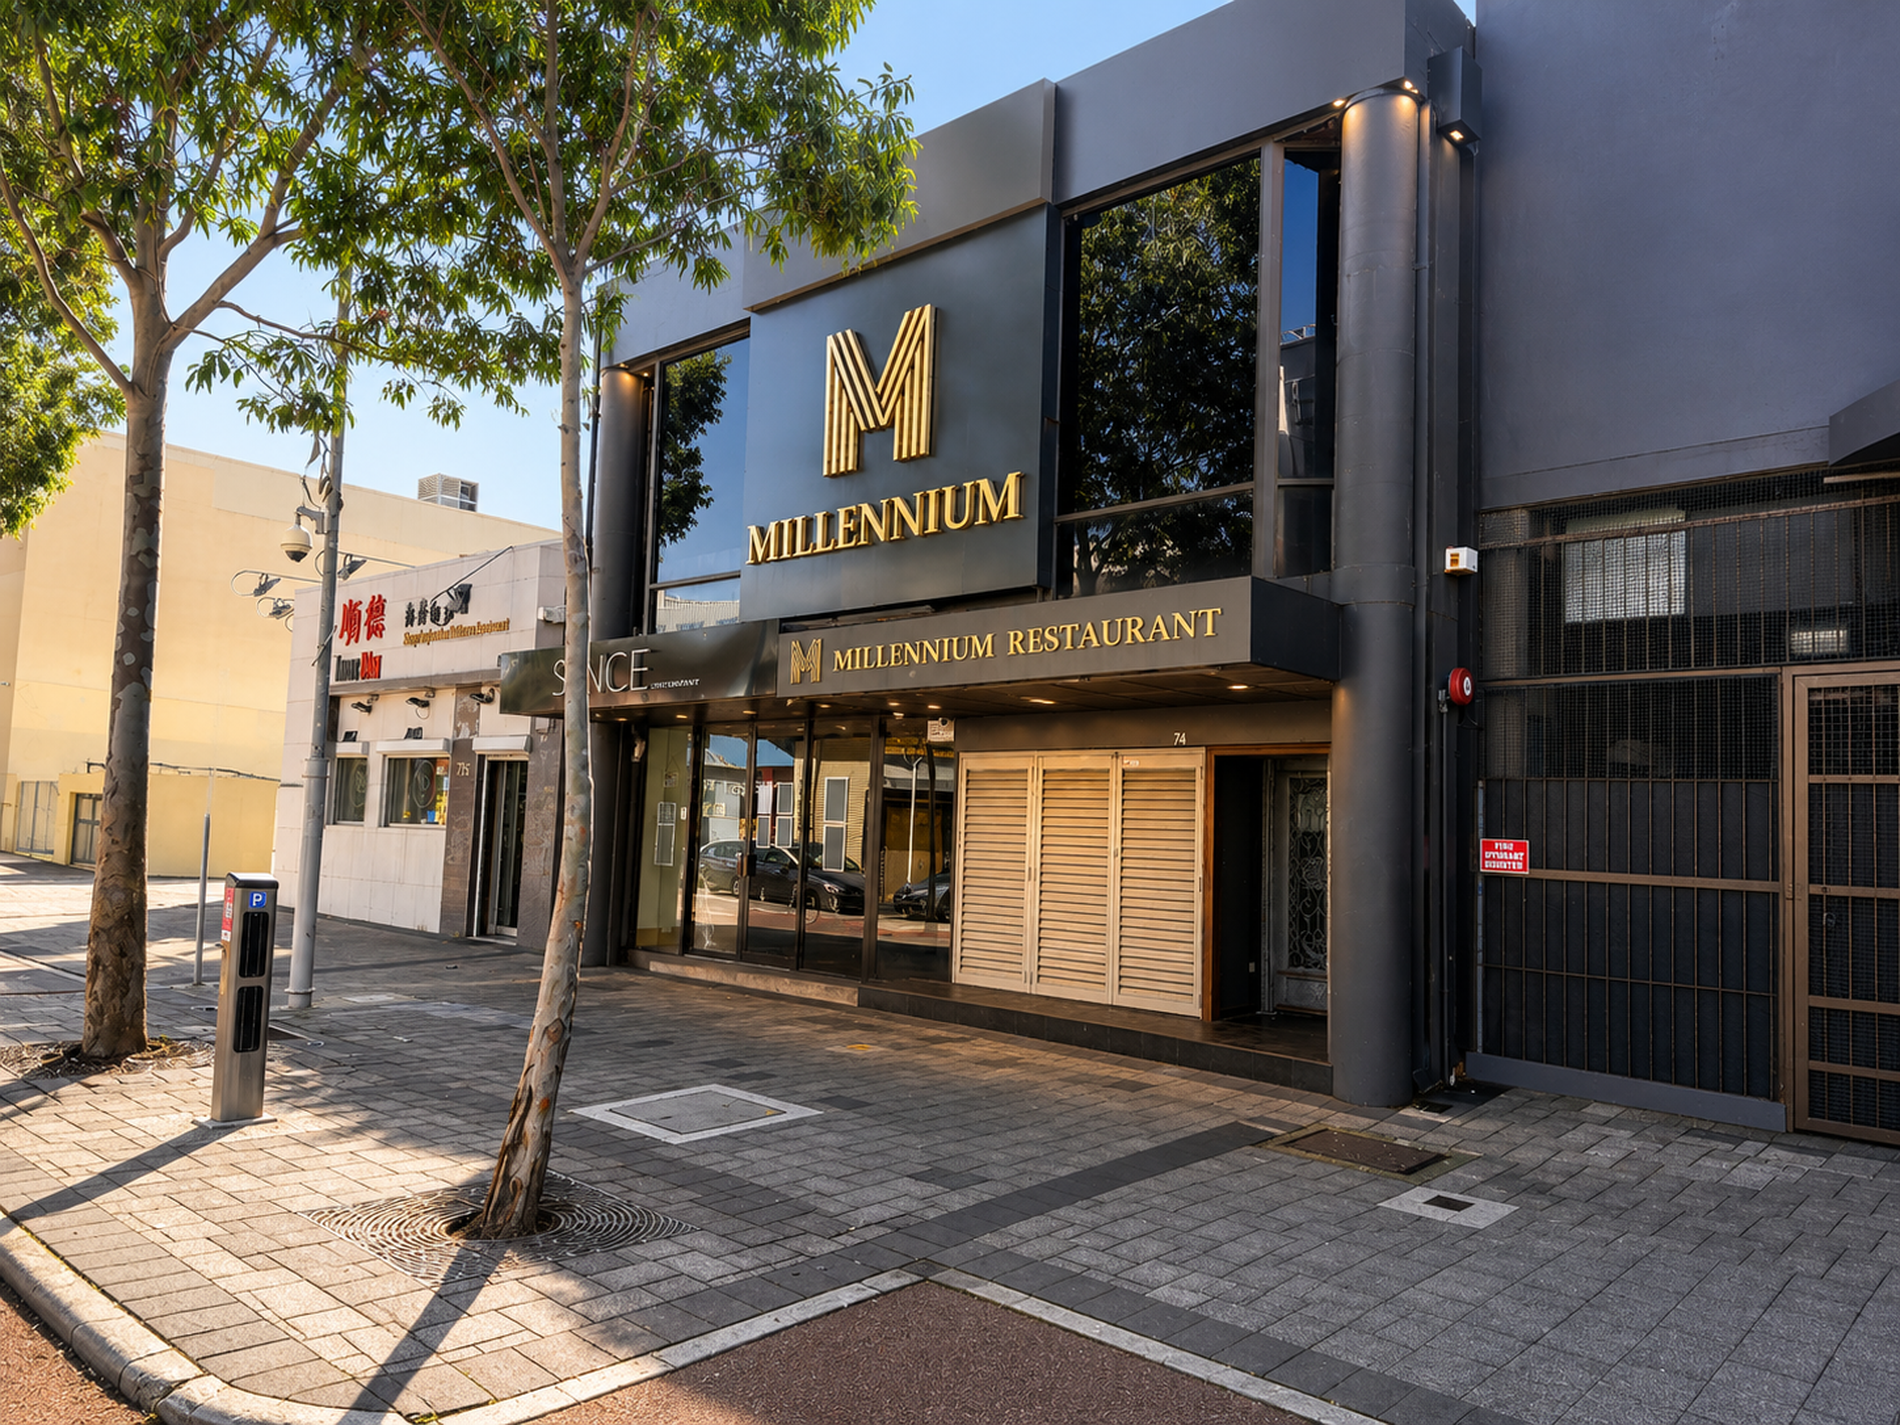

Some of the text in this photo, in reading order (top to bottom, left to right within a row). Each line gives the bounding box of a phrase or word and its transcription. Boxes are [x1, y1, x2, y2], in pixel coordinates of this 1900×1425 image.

[823, 304, 936, 477] M
[745, 471, 1025, 565] MILLENNIUM
[832, 632, 996, 672] MILLENNIUM
[1006, 607, 1222, 656] RESTAURANT
[552, 649, 649, 696] SNCE
[1174, 732, 1187, 746] 74
[253, 893, 262, 906] P
